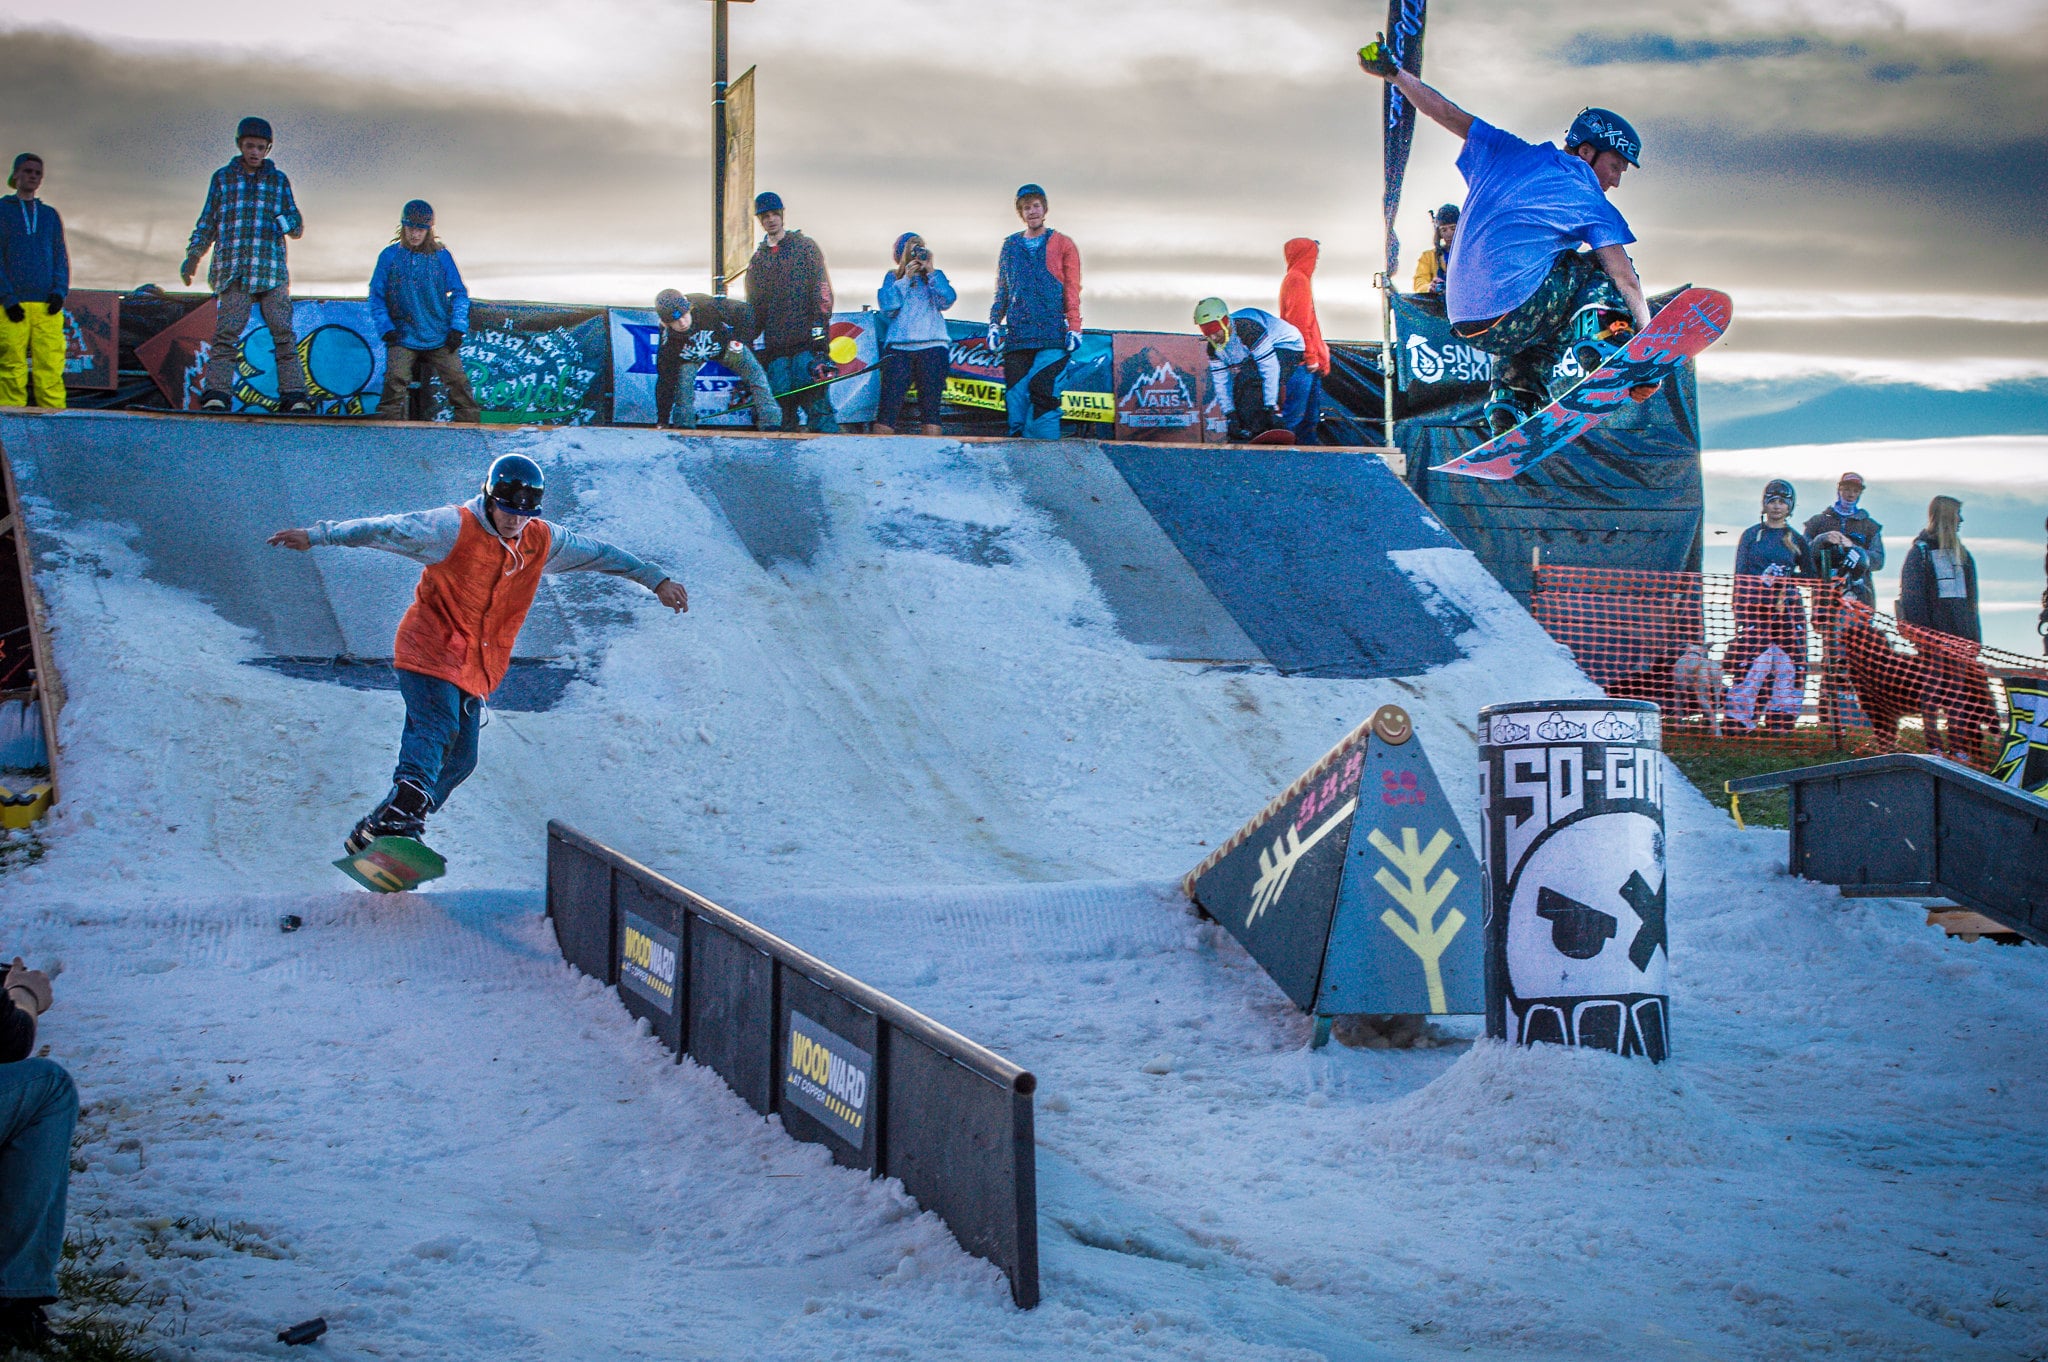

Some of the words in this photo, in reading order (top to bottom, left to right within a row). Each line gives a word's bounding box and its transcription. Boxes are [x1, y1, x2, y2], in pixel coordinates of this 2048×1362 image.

[463, 361, 572, 420] Royal
[954, 382, 997, 401] HAVE
[1135, 389, 1181, 407] VANS
[1063, 408, 1102, 420] adofans
[624, 926, 676, 983] WOODWARD
[792, 1030, 866, 1109] WOODWARD
[792, 1074, 802, 1087] AT
[801, 1079, 827, 1104] COPPER
